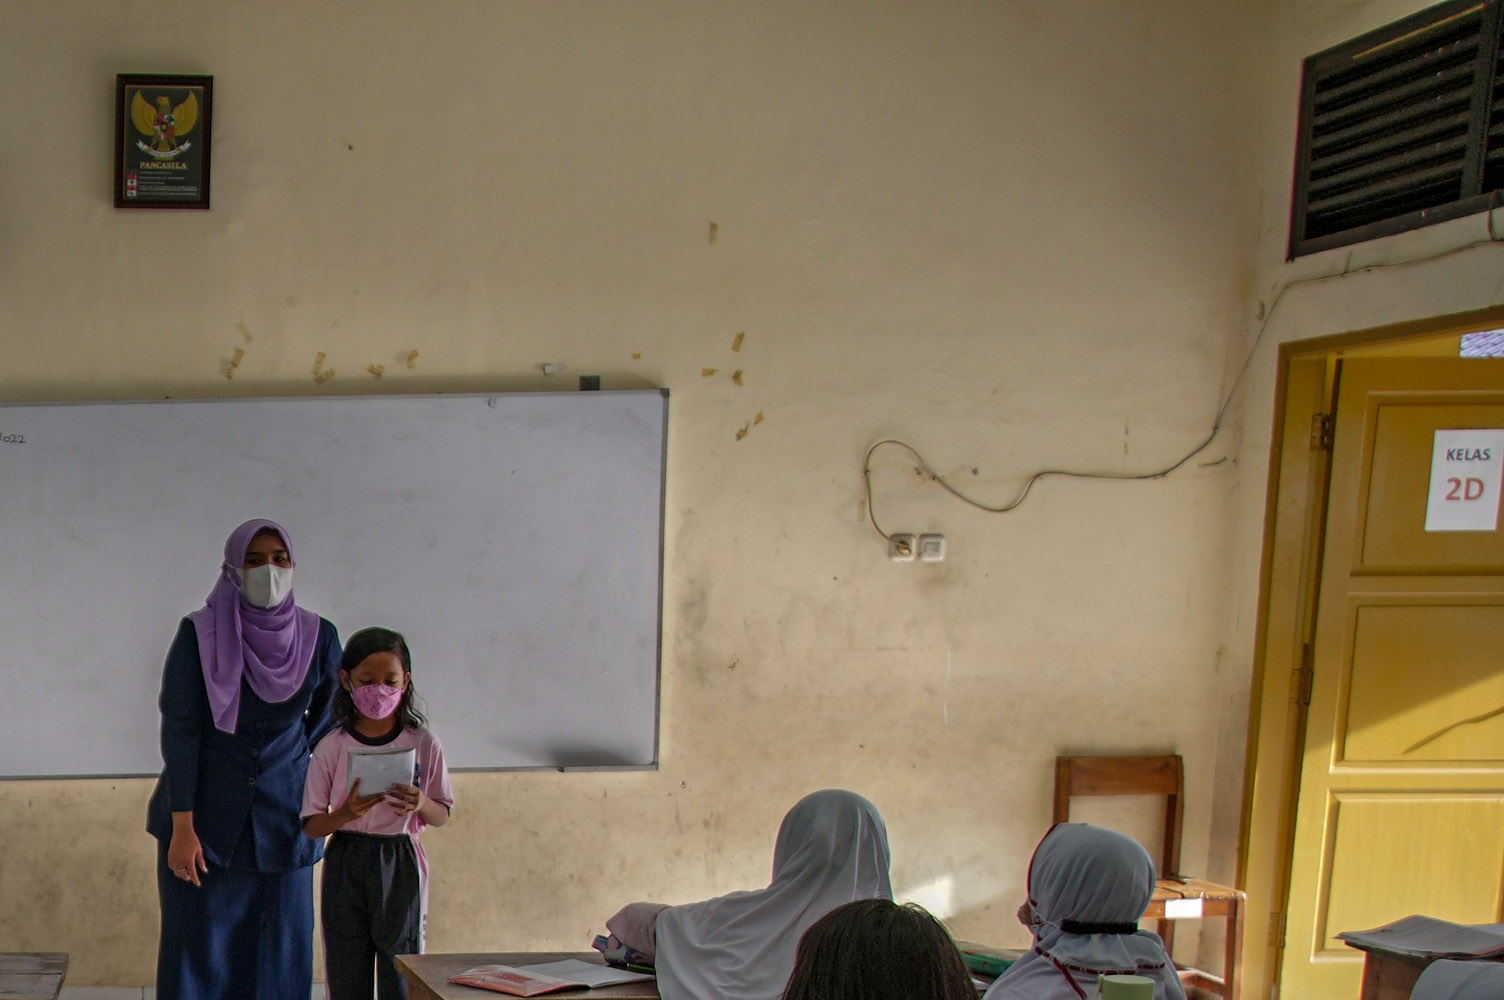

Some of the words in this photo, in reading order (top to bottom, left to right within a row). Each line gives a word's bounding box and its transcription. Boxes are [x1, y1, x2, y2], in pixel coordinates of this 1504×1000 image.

[139, 161, 188, 170] PANCASILA
[1446, 448, 1491, 461] KELAS
[1445, 477, 1485, 501] 2D
